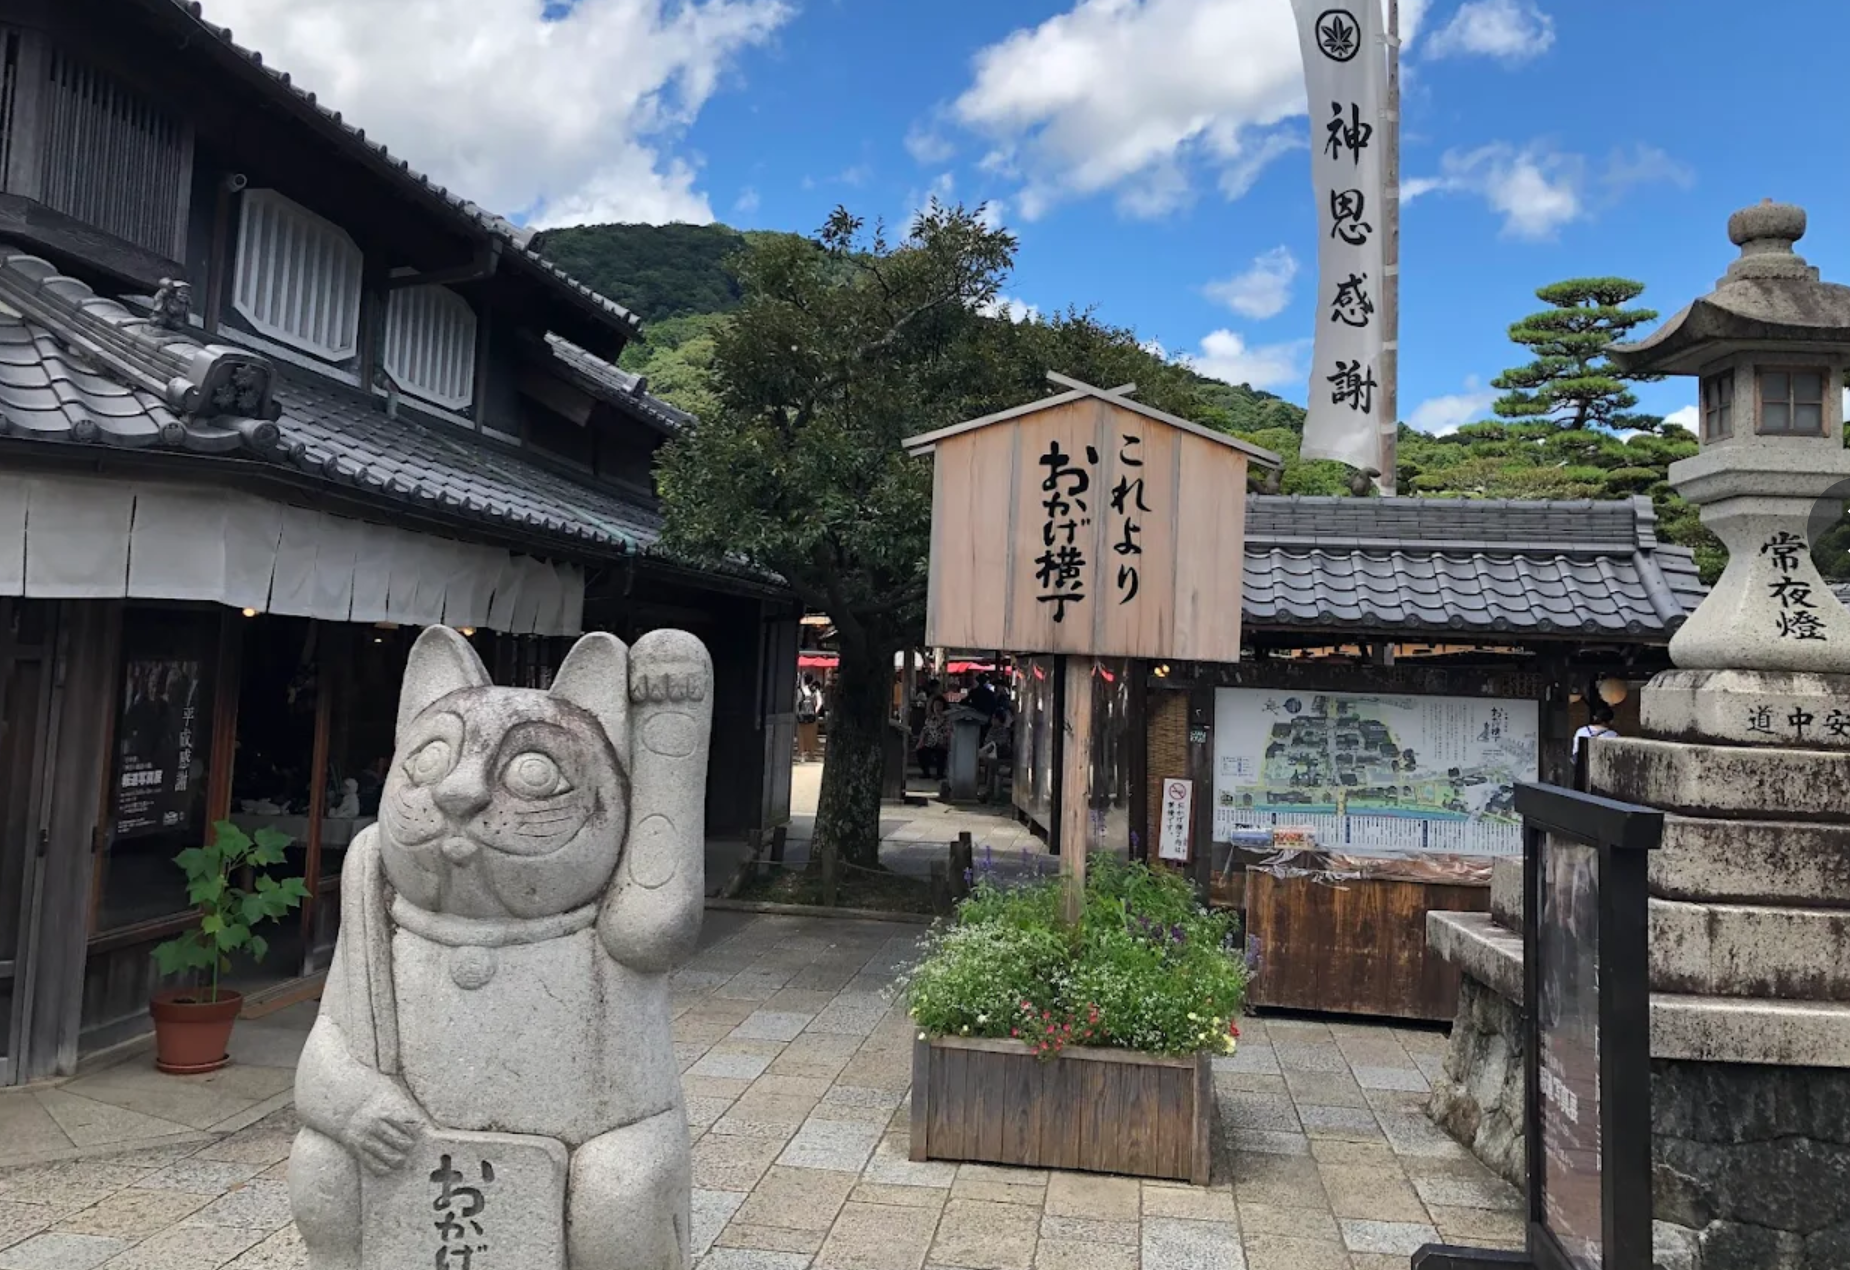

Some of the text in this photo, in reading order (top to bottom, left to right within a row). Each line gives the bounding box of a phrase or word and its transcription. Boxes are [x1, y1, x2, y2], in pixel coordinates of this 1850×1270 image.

[1324, 101, 1378, 415] 神恩感謝
[1034, 440, 1100, 623] おかげ横丁
[1110, 434, 1152, 605] これより
[1758, 531, 1828, 641] 常夜燈
[1747, 705, 1850, 737] 道中安
[429, 1154, 496, 1270] おかげ
